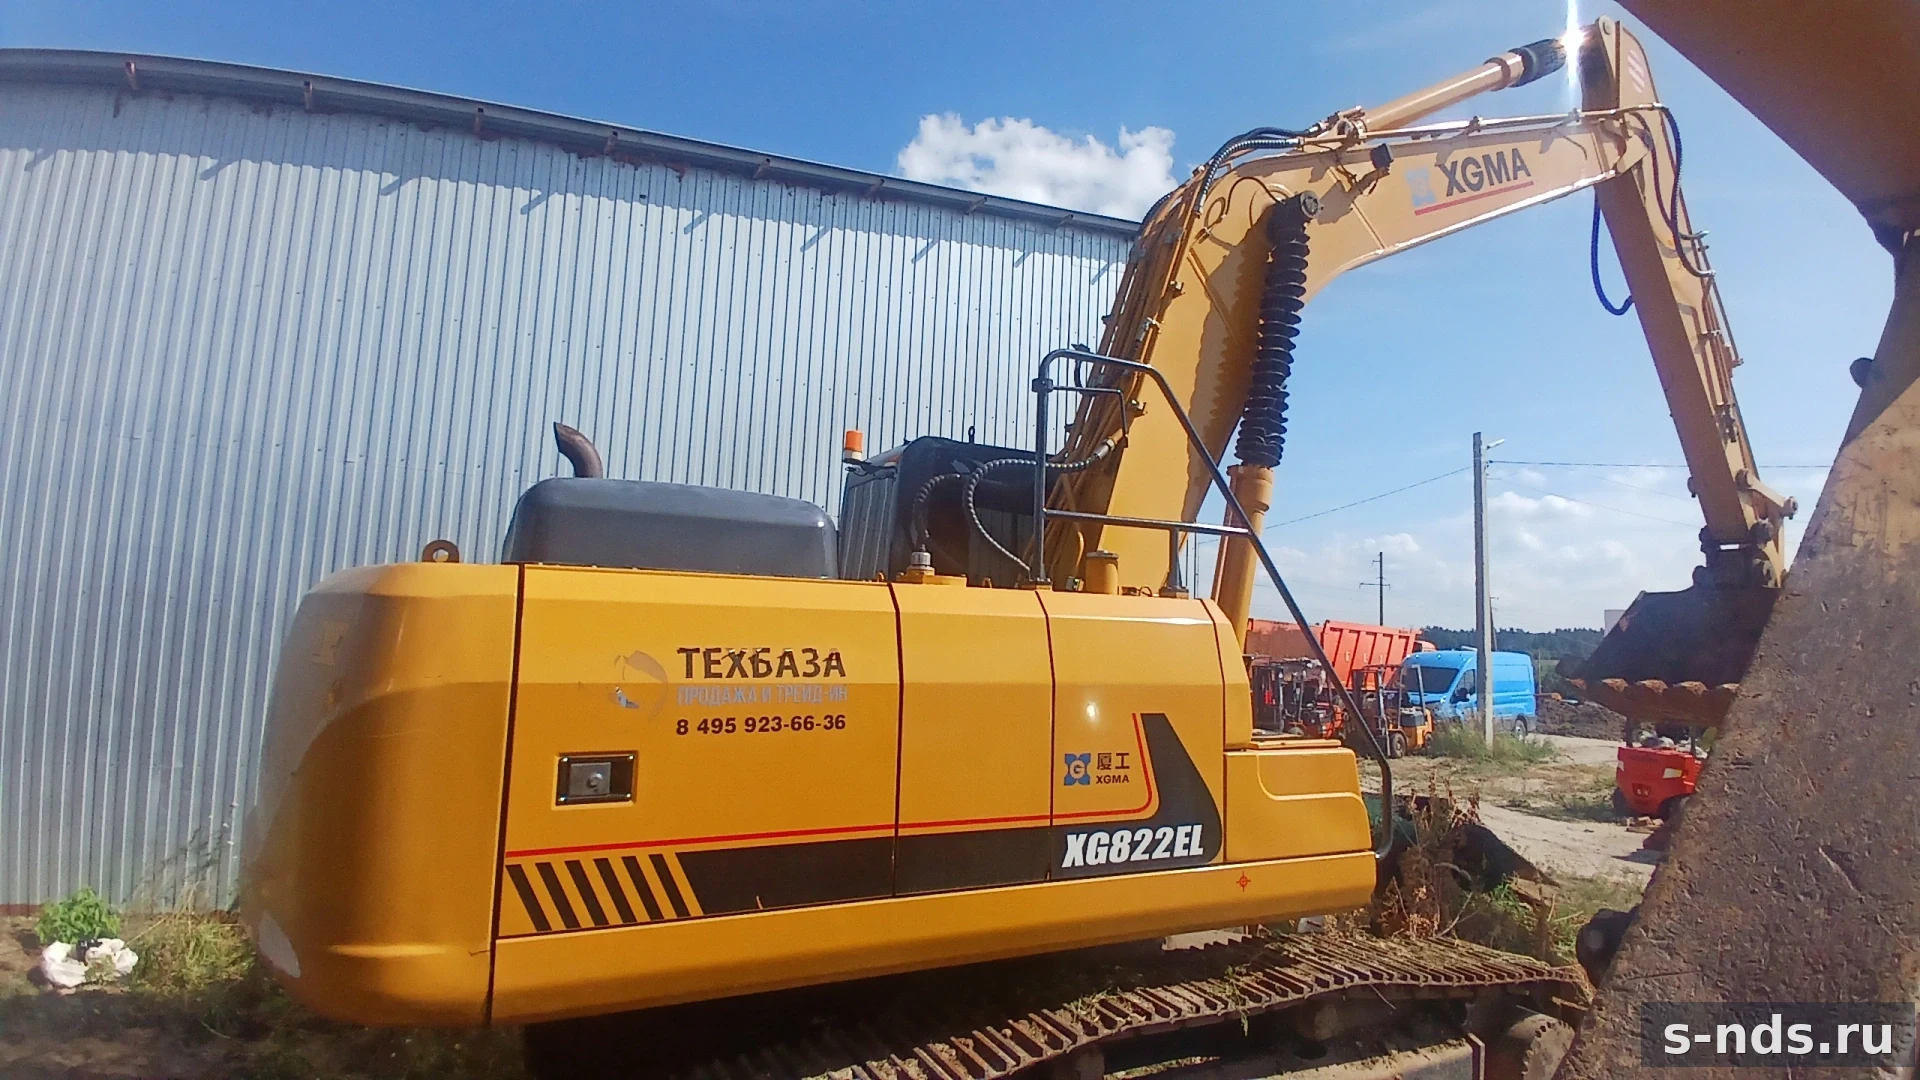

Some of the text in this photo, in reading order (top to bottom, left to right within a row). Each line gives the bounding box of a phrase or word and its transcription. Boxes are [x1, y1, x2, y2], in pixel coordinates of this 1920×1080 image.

[1439, 147, 1532, 197] XGMA
[676, 647, 847, 679] ТЕХБАЗА
[677, 686, 757, 707] ПРОДАЖА
[761, 686, 772, 703] И
[676, 714, 847, 735] 8 495 923-66-36
[1097, 752, 1130, 770] 厦工
[1096, 775, 1130, 784] XGMA
[1061, 824, 1204, 868] XG822EL
